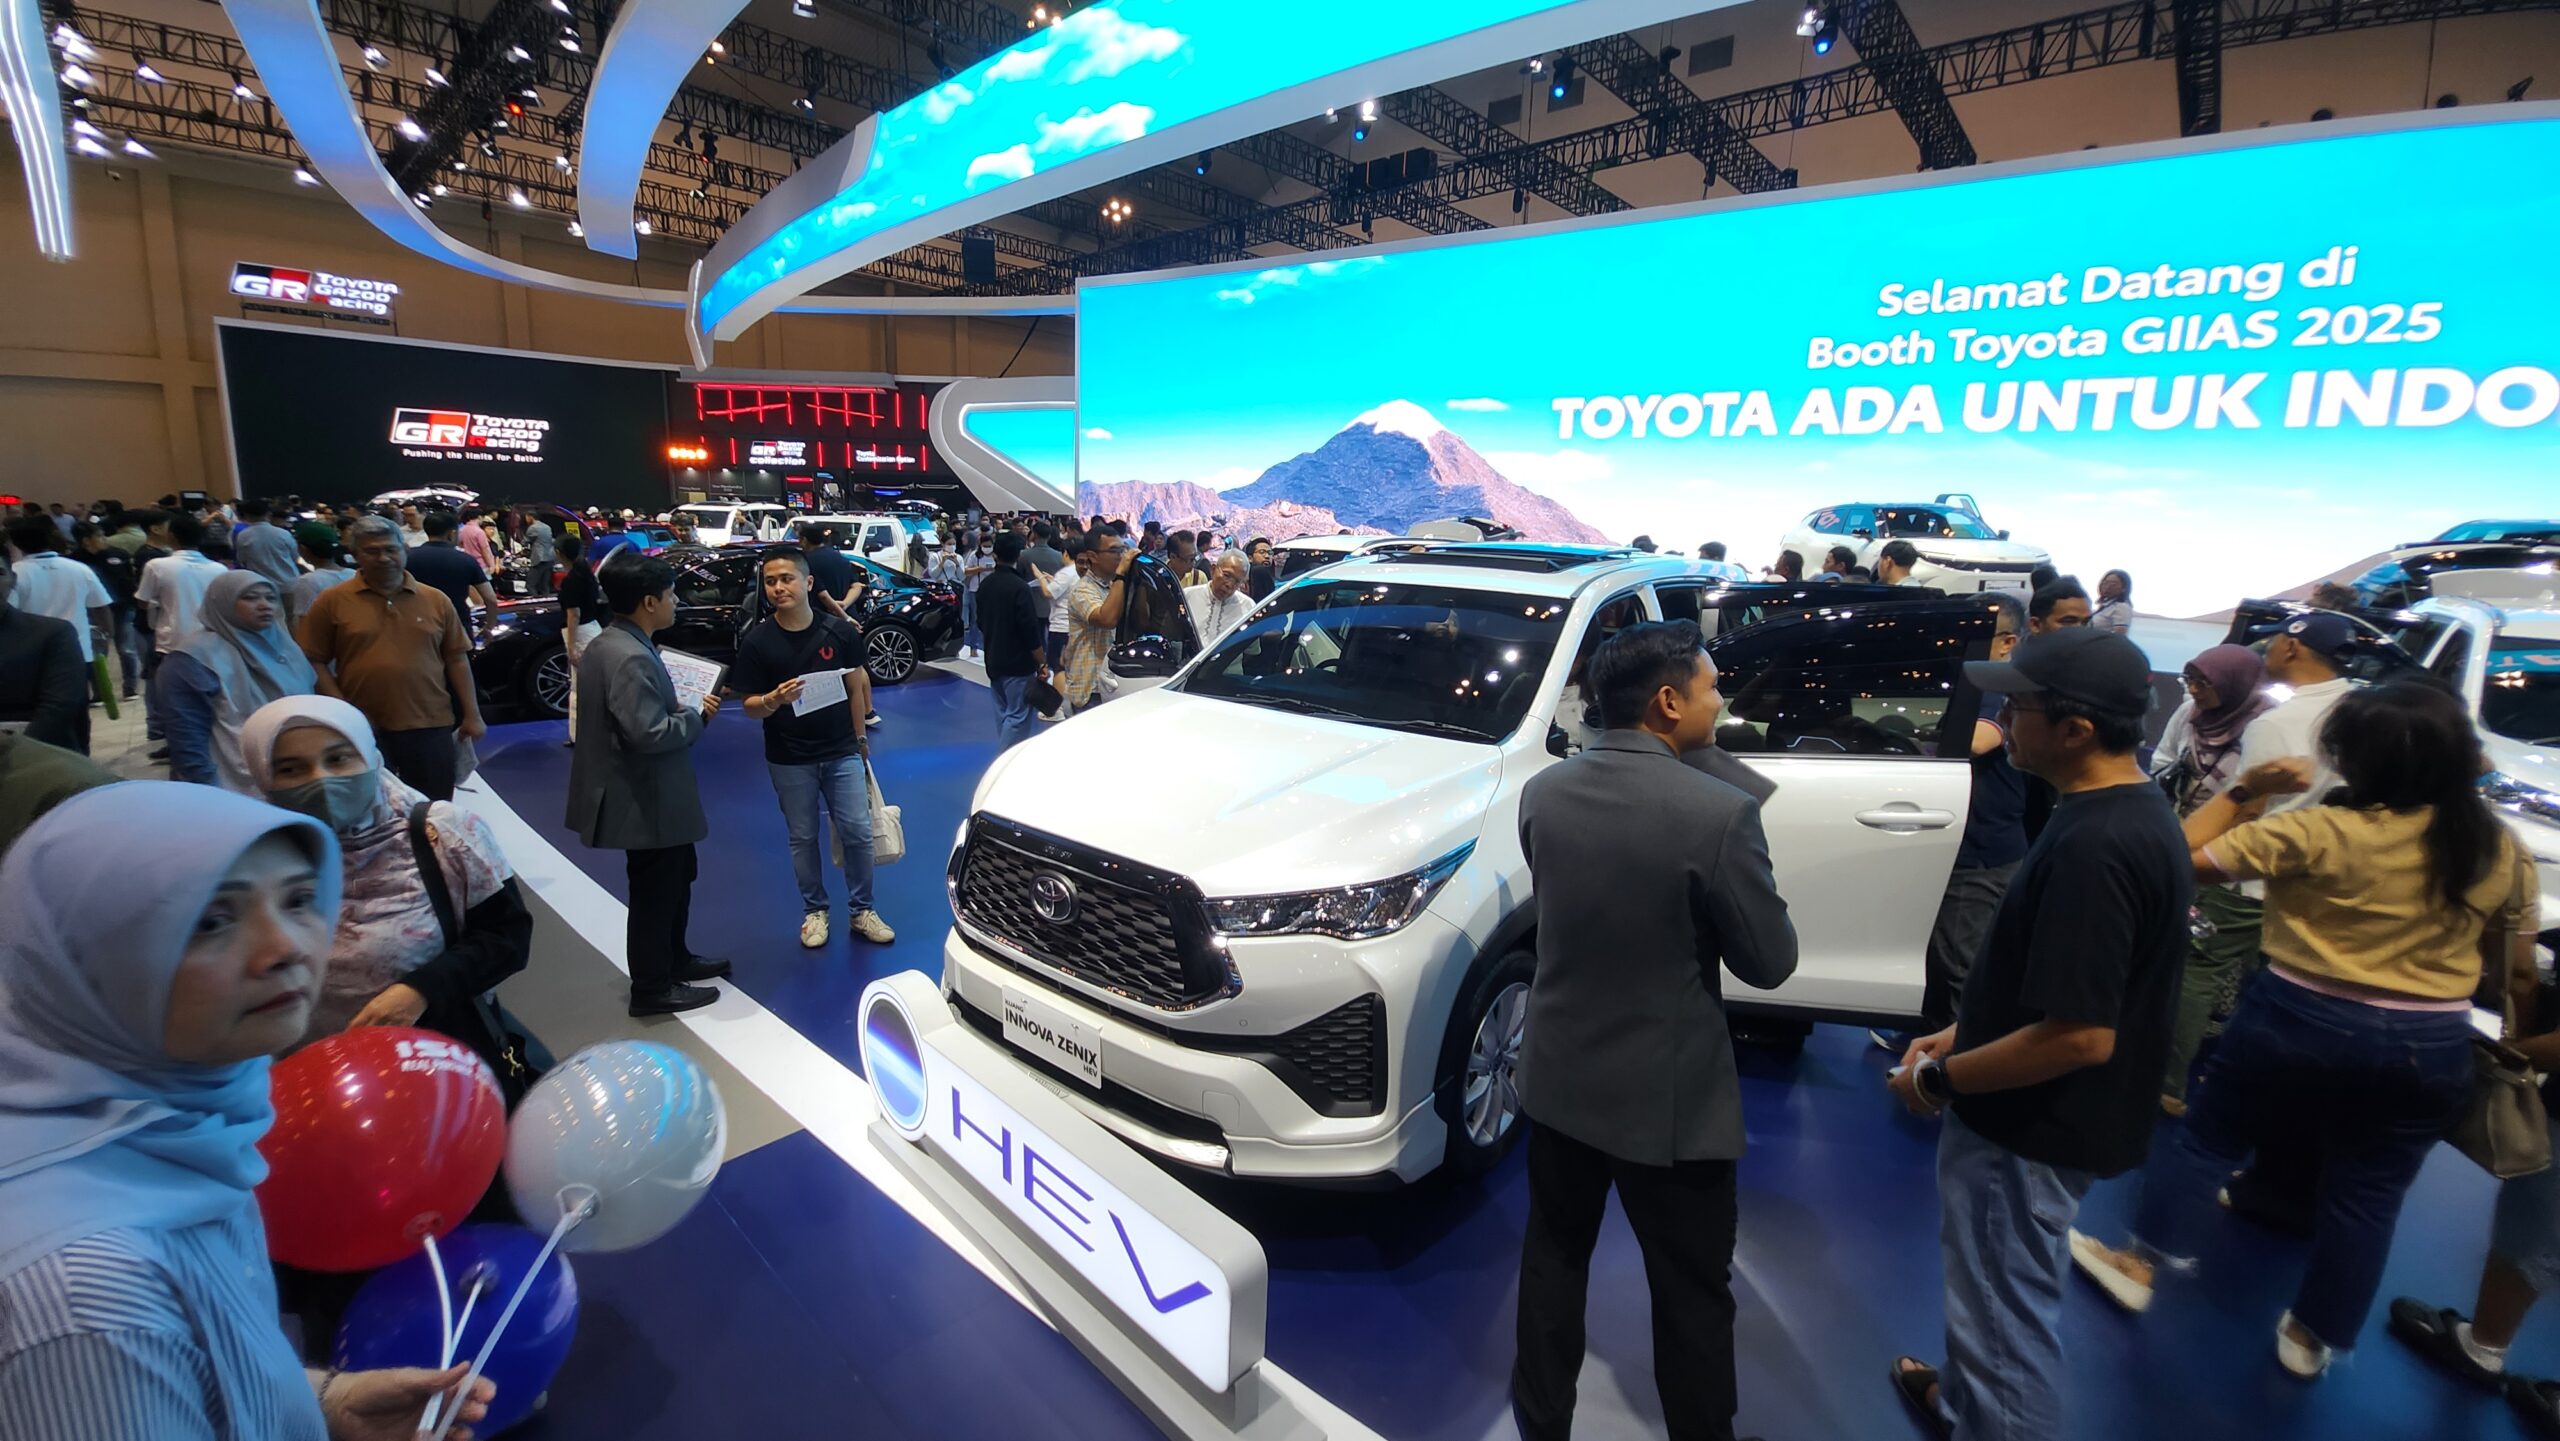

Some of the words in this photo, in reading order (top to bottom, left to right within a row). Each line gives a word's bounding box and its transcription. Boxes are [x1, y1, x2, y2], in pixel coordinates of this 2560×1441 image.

[233, 274, 308, 300] GR
[315, 272, 399, 294] TOYOTA
[1876, 272, 2071, 317] Selamat
[2080, 260, 2285, 302] Datang
[2297, 245, 2360, 288] di
[314, 283, 390, 303] GAZOO
[1806, 329, 1936, 369] Booth
[1948, 324, 2108, 369] Toyota
[2120, 310, 2280, 354] GIIAS
[2290, 300, 2444, 347] 2025
[1552, 390, 1779, 441] TOYOTA
[1789, 383, 1945, 436] ADA
[1961, 372, 2270, 434] UNTUK
[395, 421, 465, 444] GR
[470, 425, 542, 440] GAZOO
[472, 414, 550, 431] TOYOTA
[468, 435, 540, 452] Racing
[403, 449, 443, 459] Pushing
[446, 451, 462, 459] the
[465, 452, 493, 461] limits
[496, 453, 511, 461] for
[513, 454, 544, 463] Better
[1005, 1007, 1055, 1046] INNOVA
[1057, 1034, 1098, 1068] ZENIX
[1083, 1065, 1098, 1077] HEV
[951, 1085, 1213, 1315] HEV
